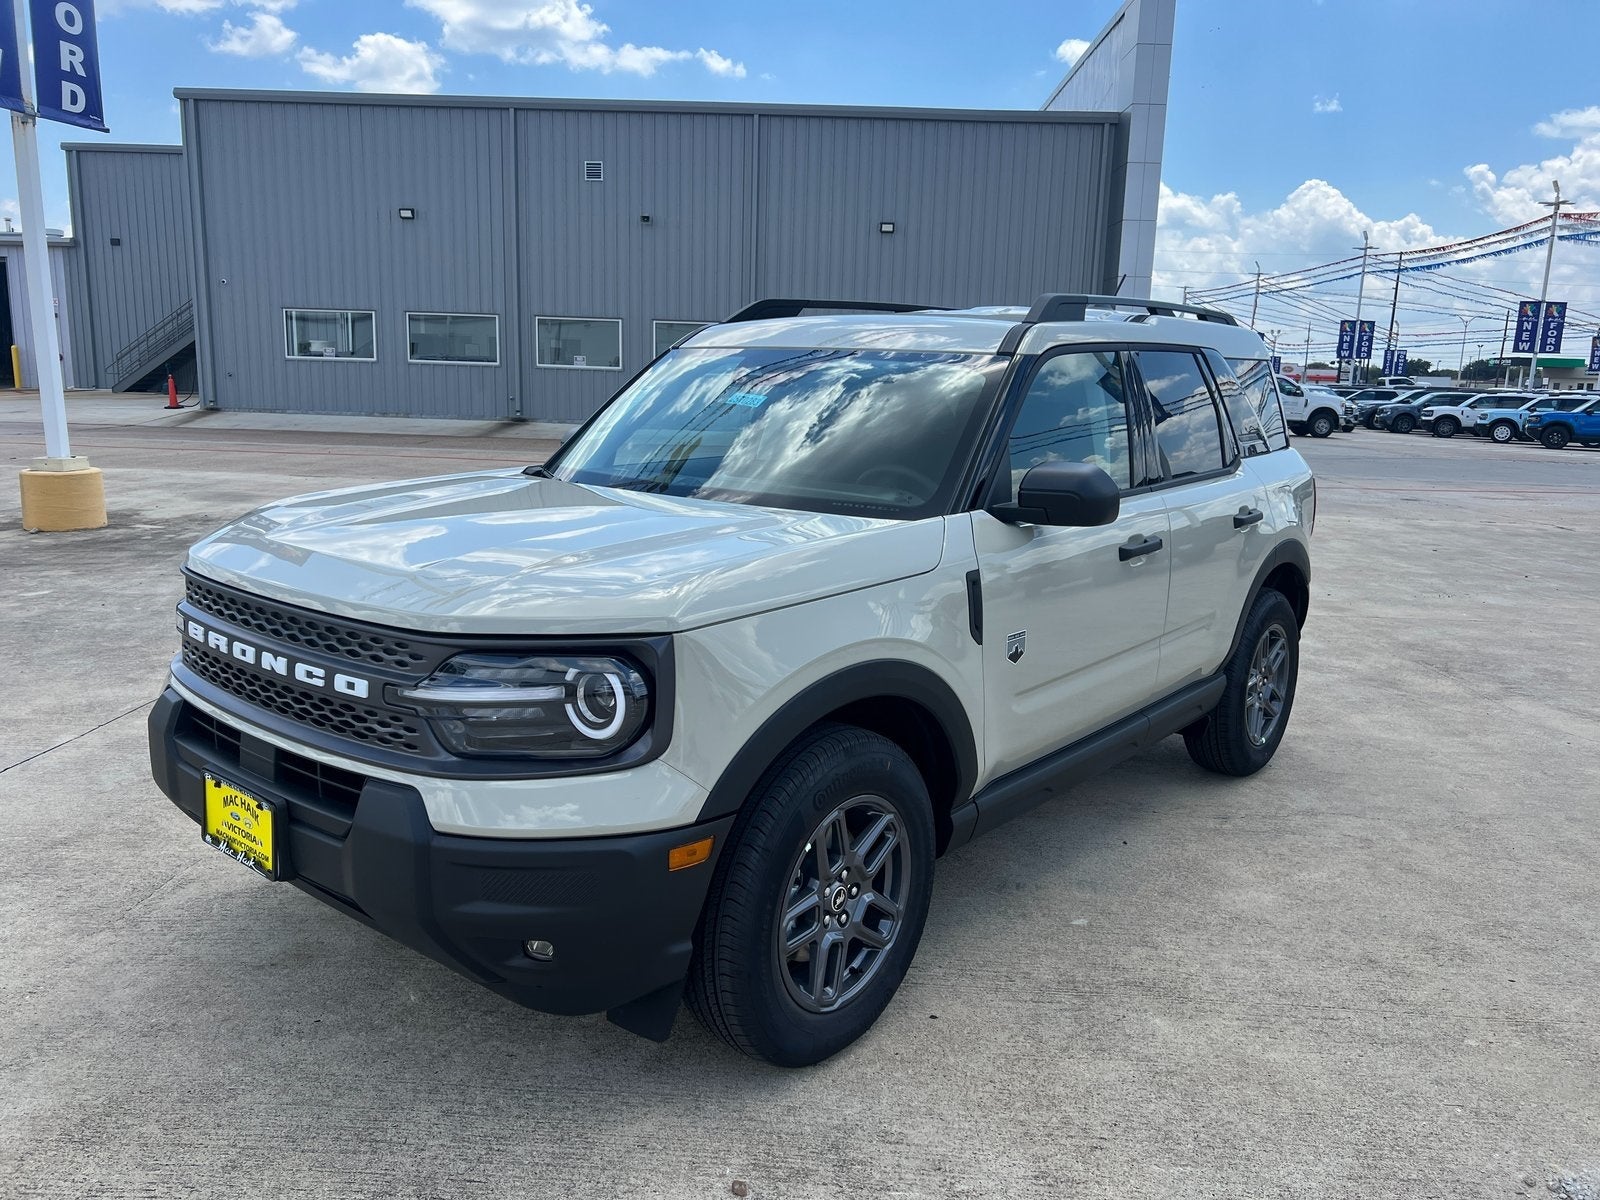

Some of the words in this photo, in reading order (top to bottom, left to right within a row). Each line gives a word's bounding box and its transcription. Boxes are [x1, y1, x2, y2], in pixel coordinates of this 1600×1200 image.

[1340, 335, 1351, 357] NEW
[1361, 336, 1369, 357] FORD
[1519, 321, 1532, 350] NEW
[1546, 322, 1558, 352] FORD
[1592, 350, 1600, 370] NEW
[188, 620, 369, 699] BRONCO
[223, 795, 239, 808] MAC
[240, 797, 260, 826] HAIK
[227, 821, 257, 843] VICTORIA
